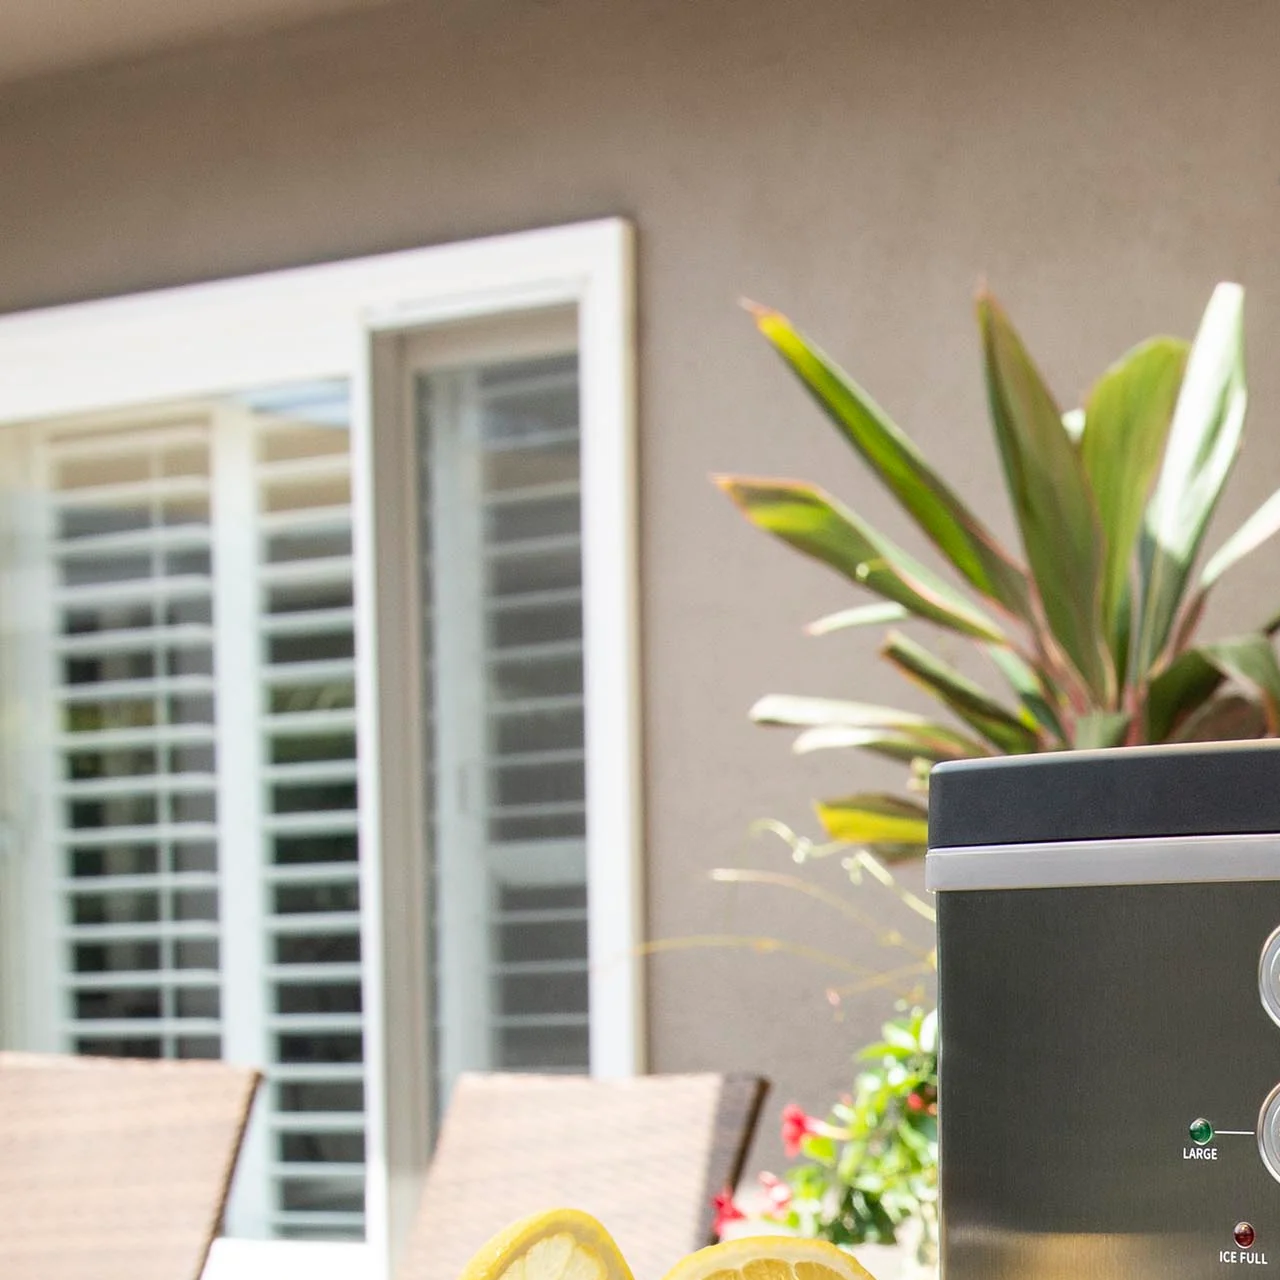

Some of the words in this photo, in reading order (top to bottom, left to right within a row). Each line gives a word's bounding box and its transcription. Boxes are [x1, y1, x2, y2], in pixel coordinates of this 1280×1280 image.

[1183, 1147, 1218, 1160] LARGE
[1219, 1251, 1237, 1264] ICE
[1240, 1252, 1268, 1265] FULL
